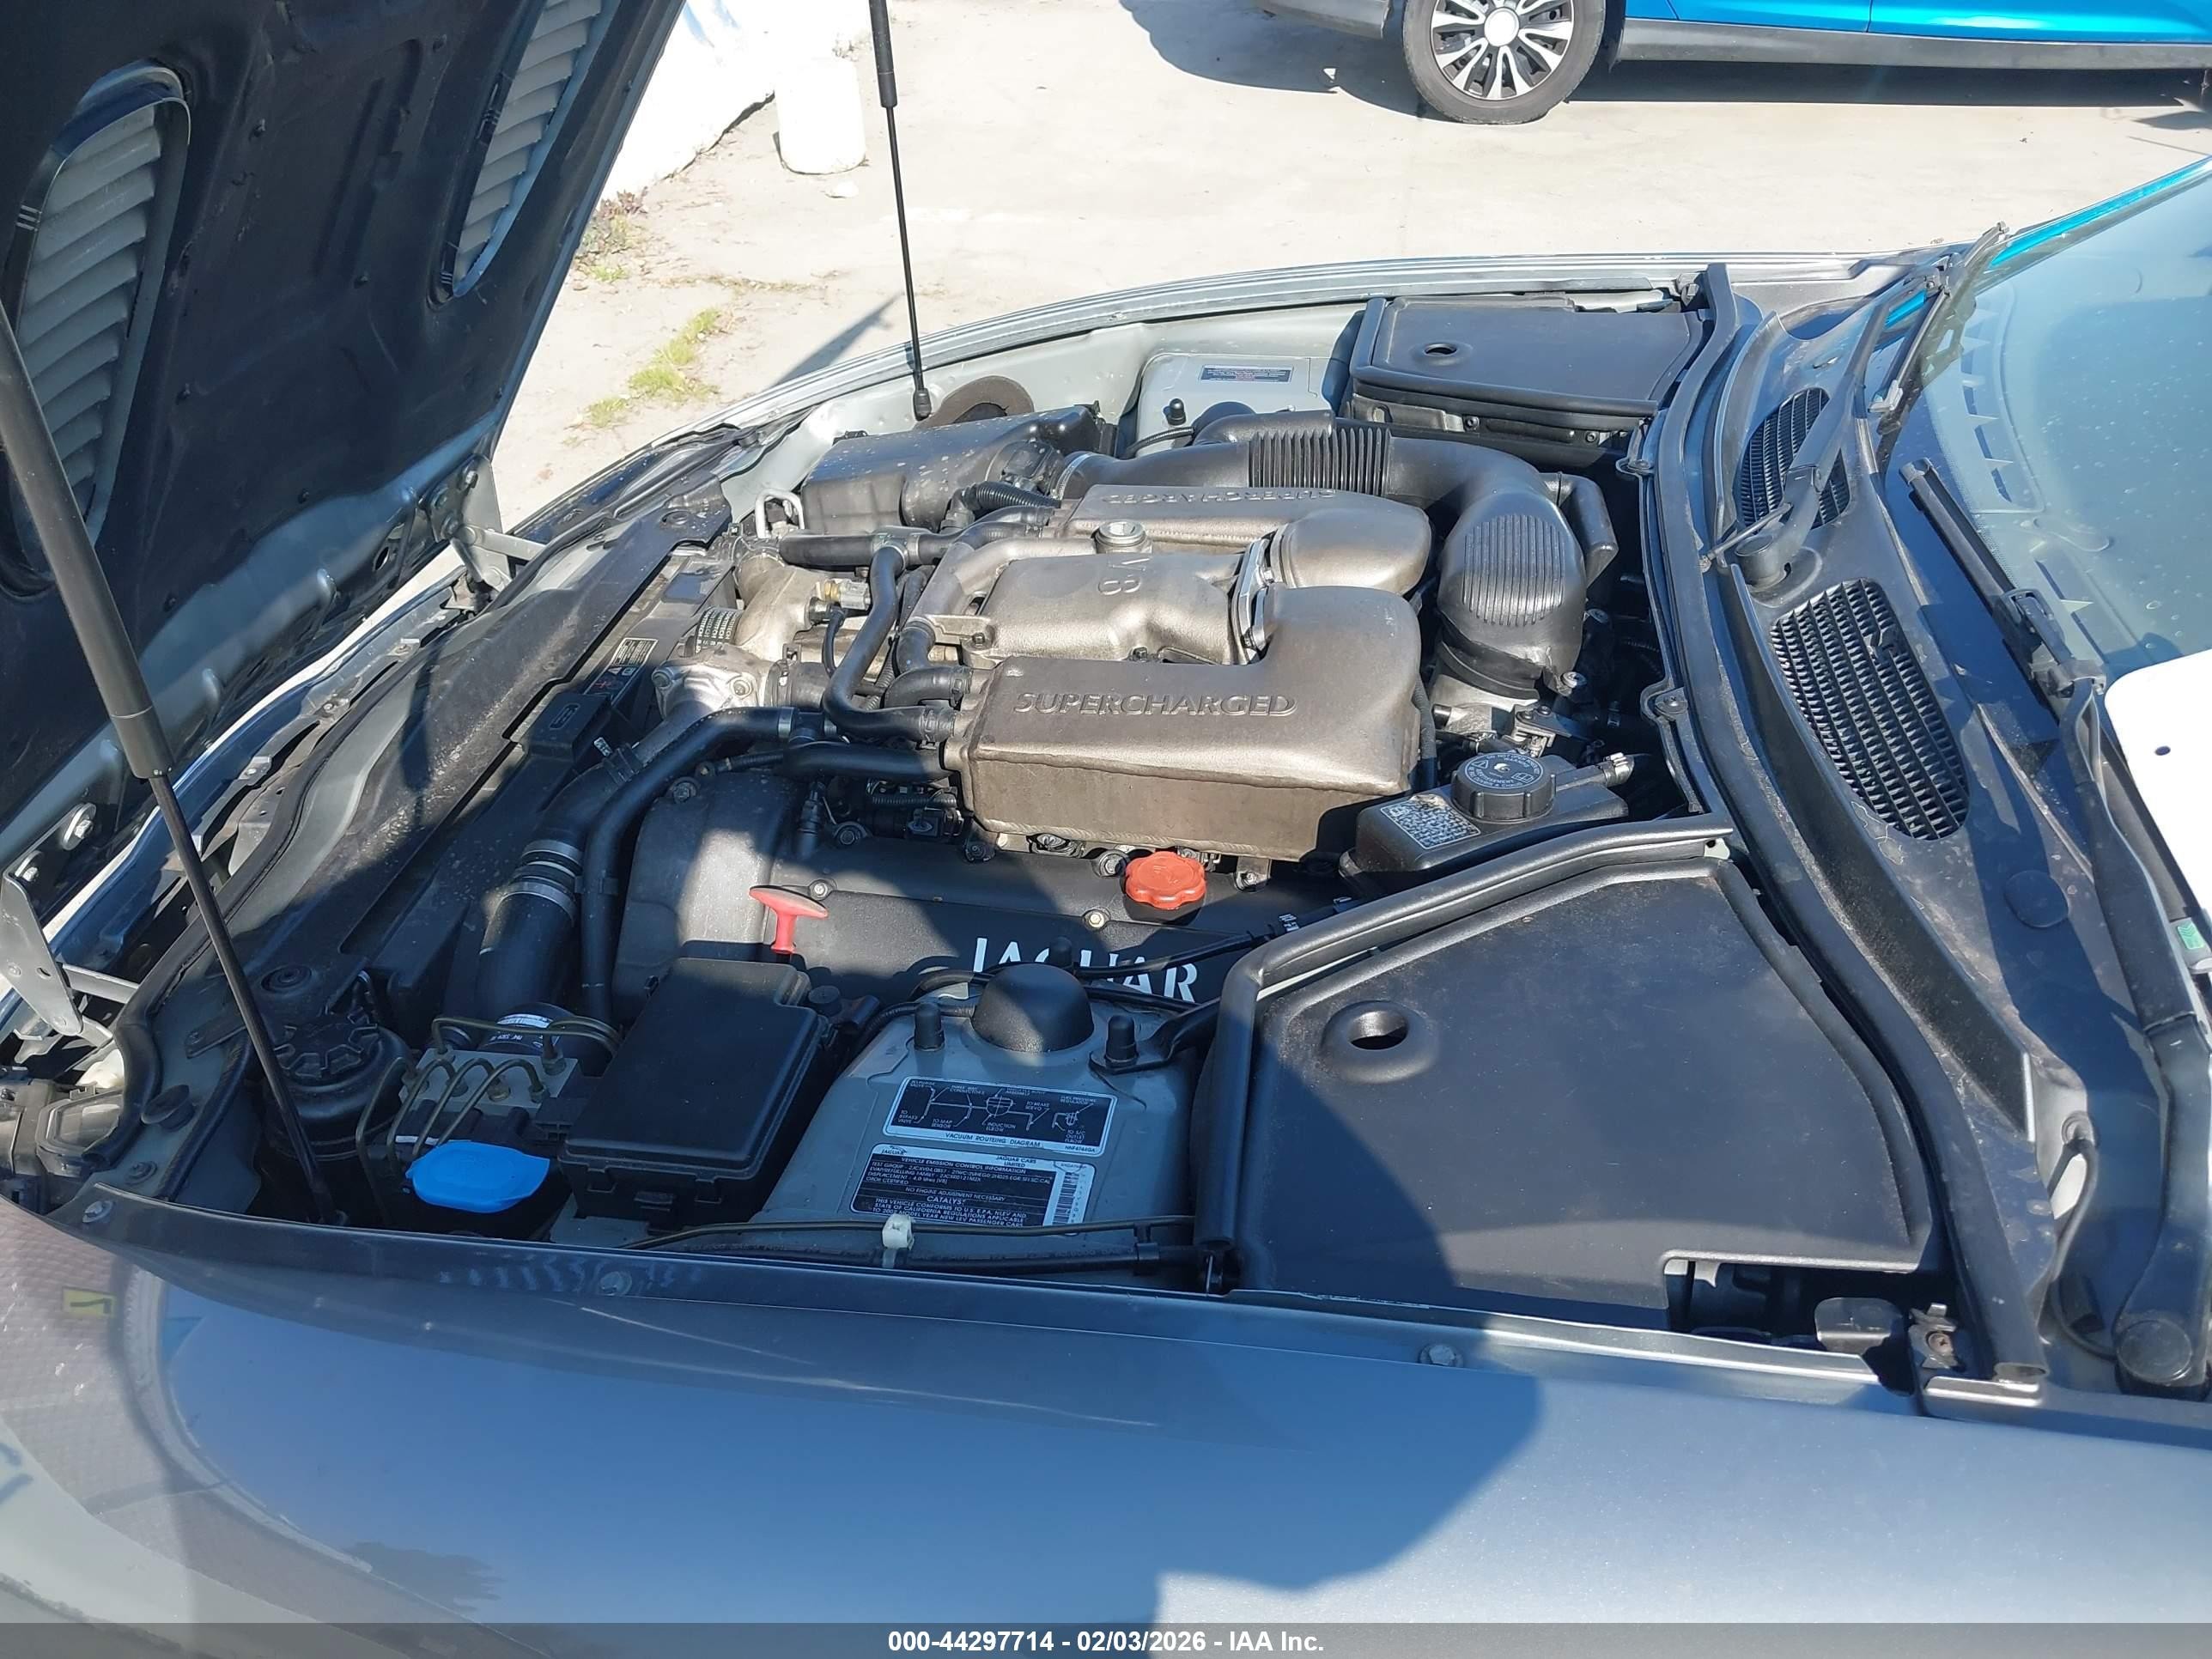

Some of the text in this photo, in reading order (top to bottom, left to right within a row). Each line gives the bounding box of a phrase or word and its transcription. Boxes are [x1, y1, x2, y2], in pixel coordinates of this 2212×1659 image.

[1105, 489, 1337, 504] SUPERCHARGED
[1098, 554, 1153, 596] V8
[1014, 692, 1297, 717] SUPERCHARGED
[974, 937, 1199, 1003] JAUAR
[985, 1165, 1026, 1175] INFORMATION
[938, 1190, 973, 1199] ADJUSTMENT
[915, 1202, 952, 1211] CONFORMS
[903, 1206, 942, 1215] CALIFORNIA
[943, 1209, 986, 1218] REGULATIONS
[987, 1213, 1024, 1223] APPLICABLE
[968, 1218, 1005, 1226] PASSENGER
